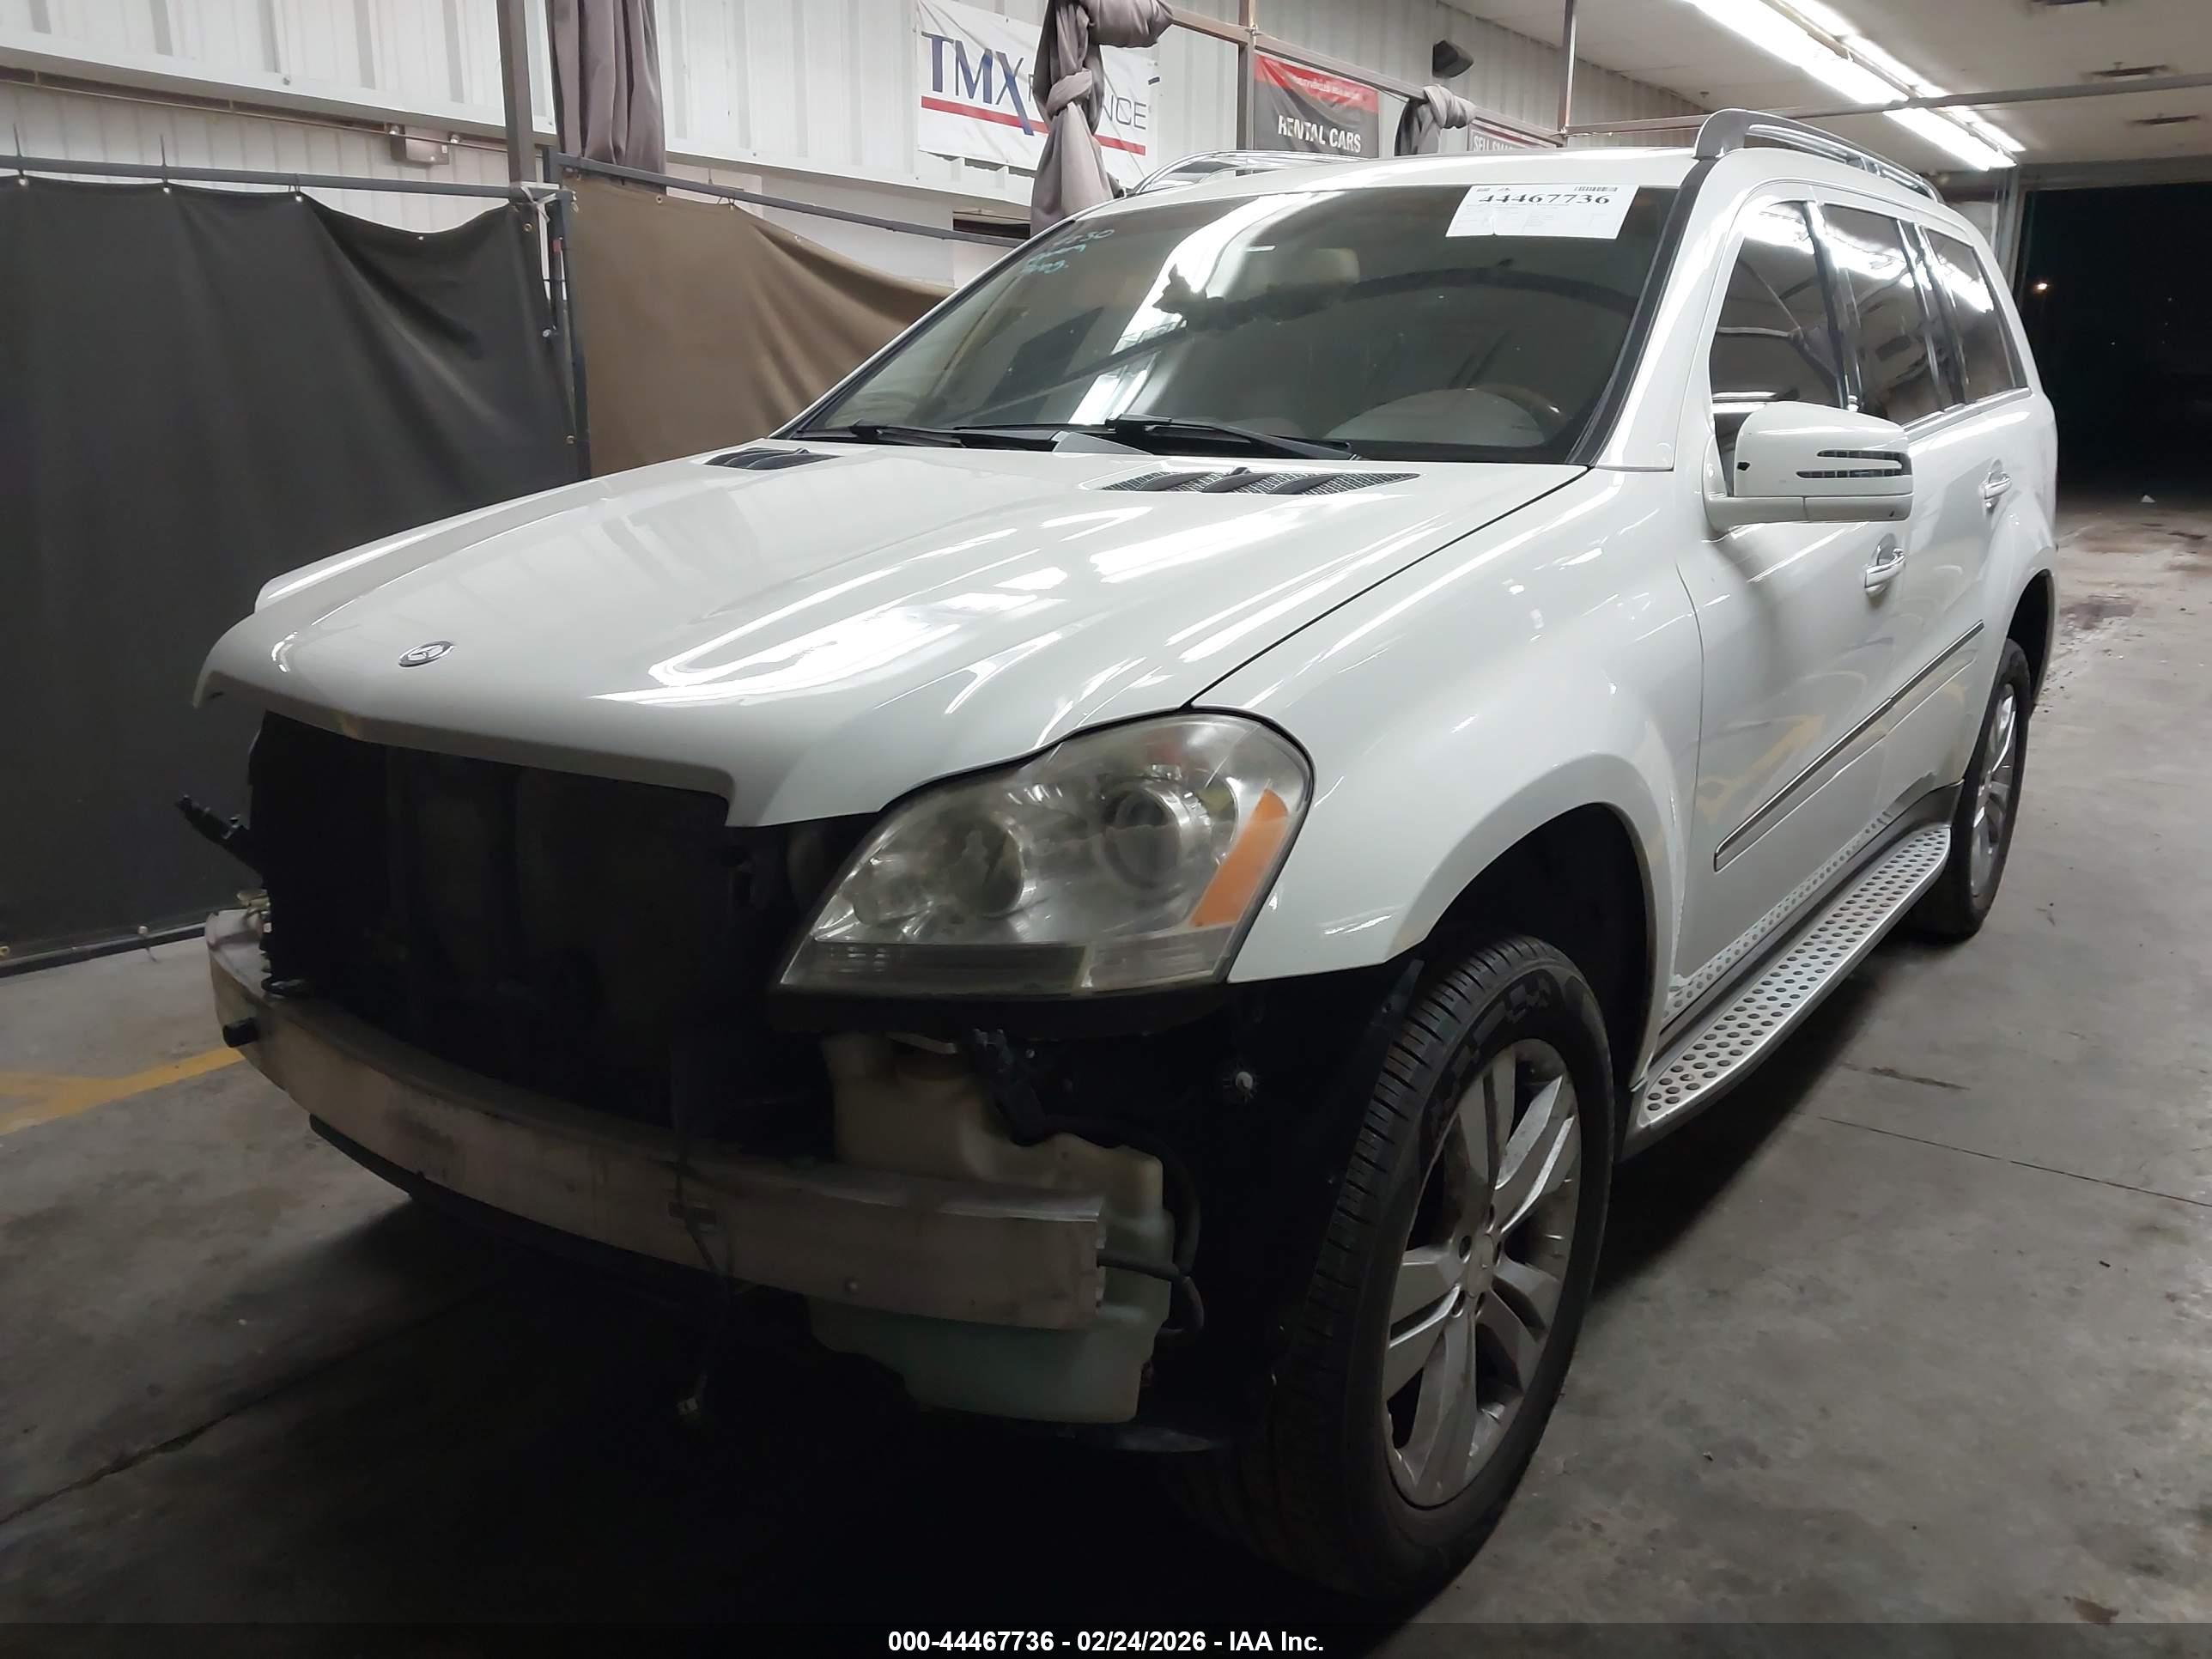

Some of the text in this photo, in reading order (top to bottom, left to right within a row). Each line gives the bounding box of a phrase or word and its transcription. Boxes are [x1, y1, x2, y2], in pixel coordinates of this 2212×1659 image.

[921, 31, 1035, 136] TMX
[1279, 115, 1361, 153] RENTAL CARS
[1479, 193, 1610, 204] 44467736
